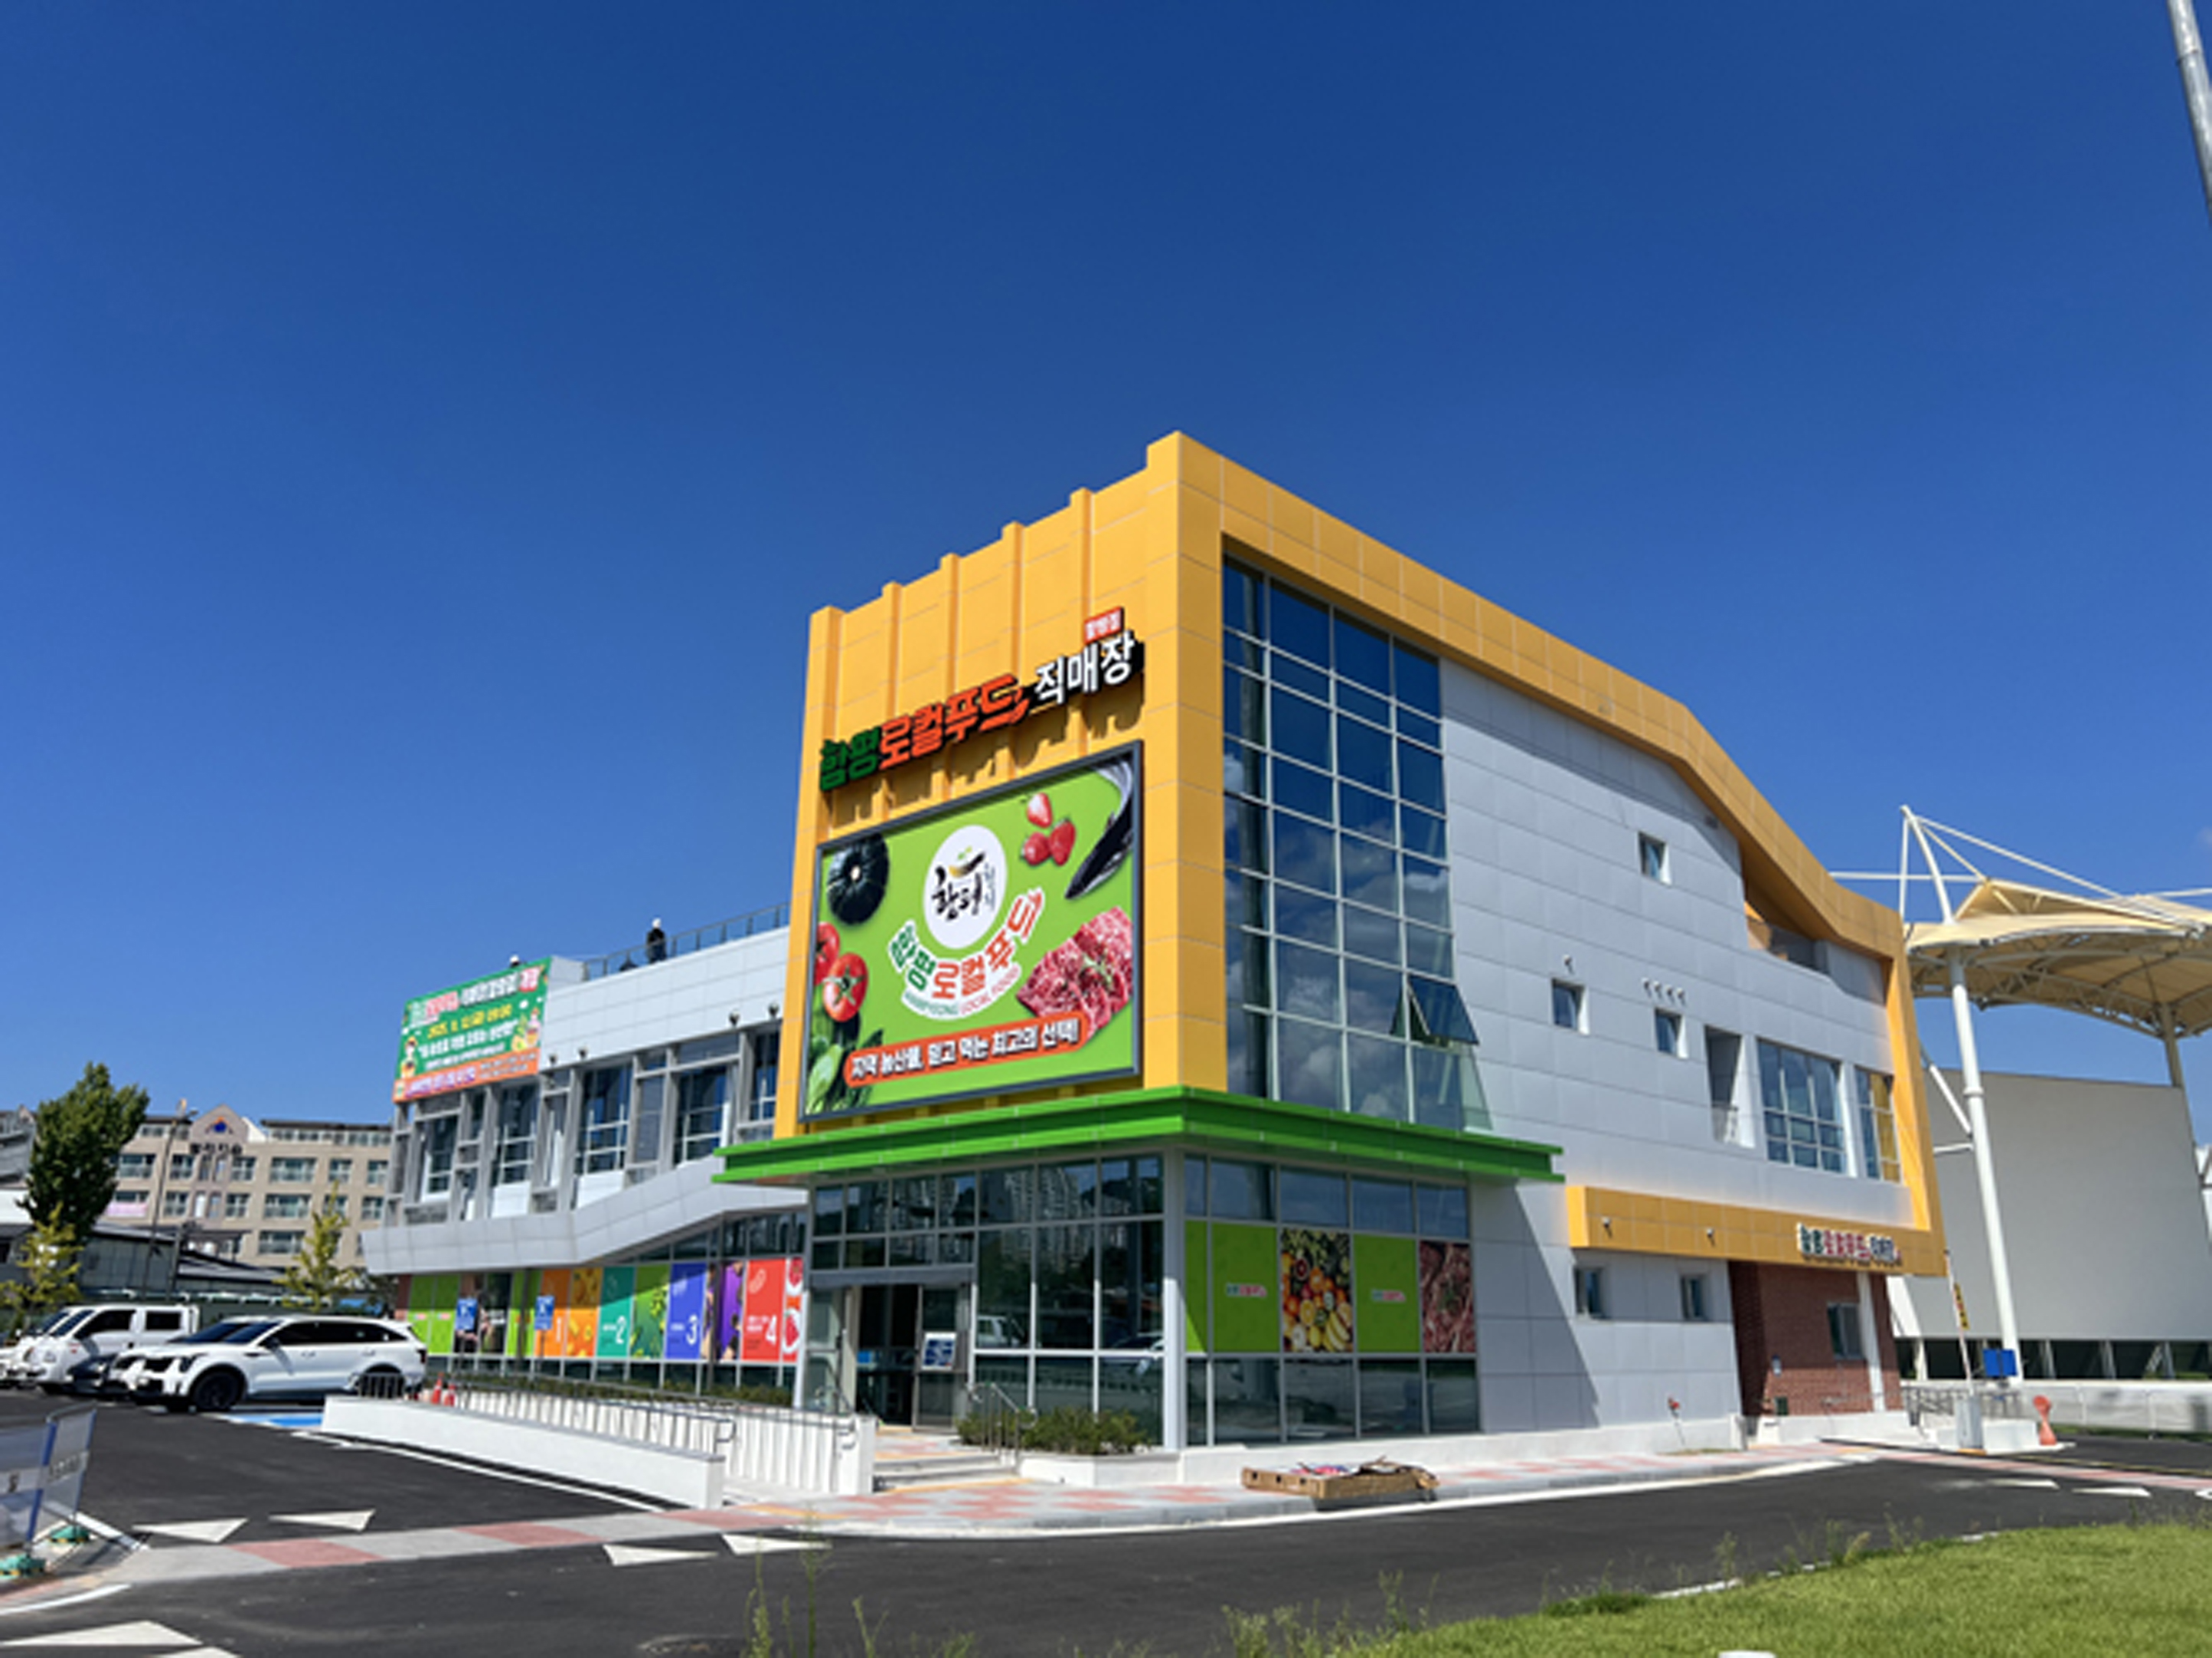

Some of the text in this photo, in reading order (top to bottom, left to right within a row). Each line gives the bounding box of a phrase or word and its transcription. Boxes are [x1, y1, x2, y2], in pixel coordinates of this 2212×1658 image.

[1035, 630, 1135, 704] 직매장
[992, 1025, 1039, 1057] 최고의
[615, 1315, 627, 1345] 2
[686, 1314, 698, 1346] 3
[765, 1314, 777, 1346] 4
